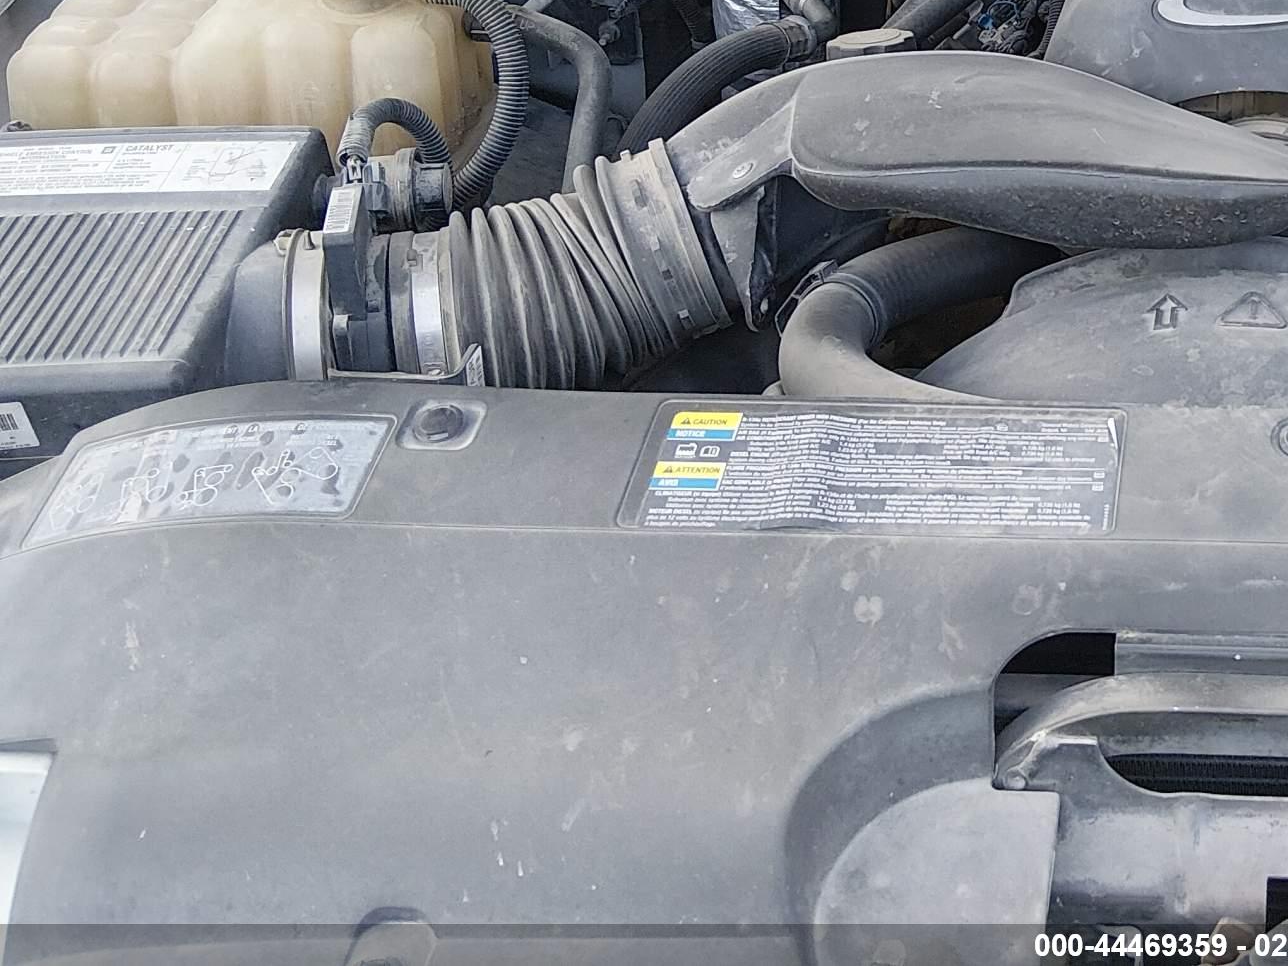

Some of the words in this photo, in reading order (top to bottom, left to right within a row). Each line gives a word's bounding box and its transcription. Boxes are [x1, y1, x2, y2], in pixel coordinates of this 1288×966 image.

[125, 144, 174, 153] CATALYST
[693, 418, 727, 426] CAUTION
[675, 466, 720, 474] ATTENTION
